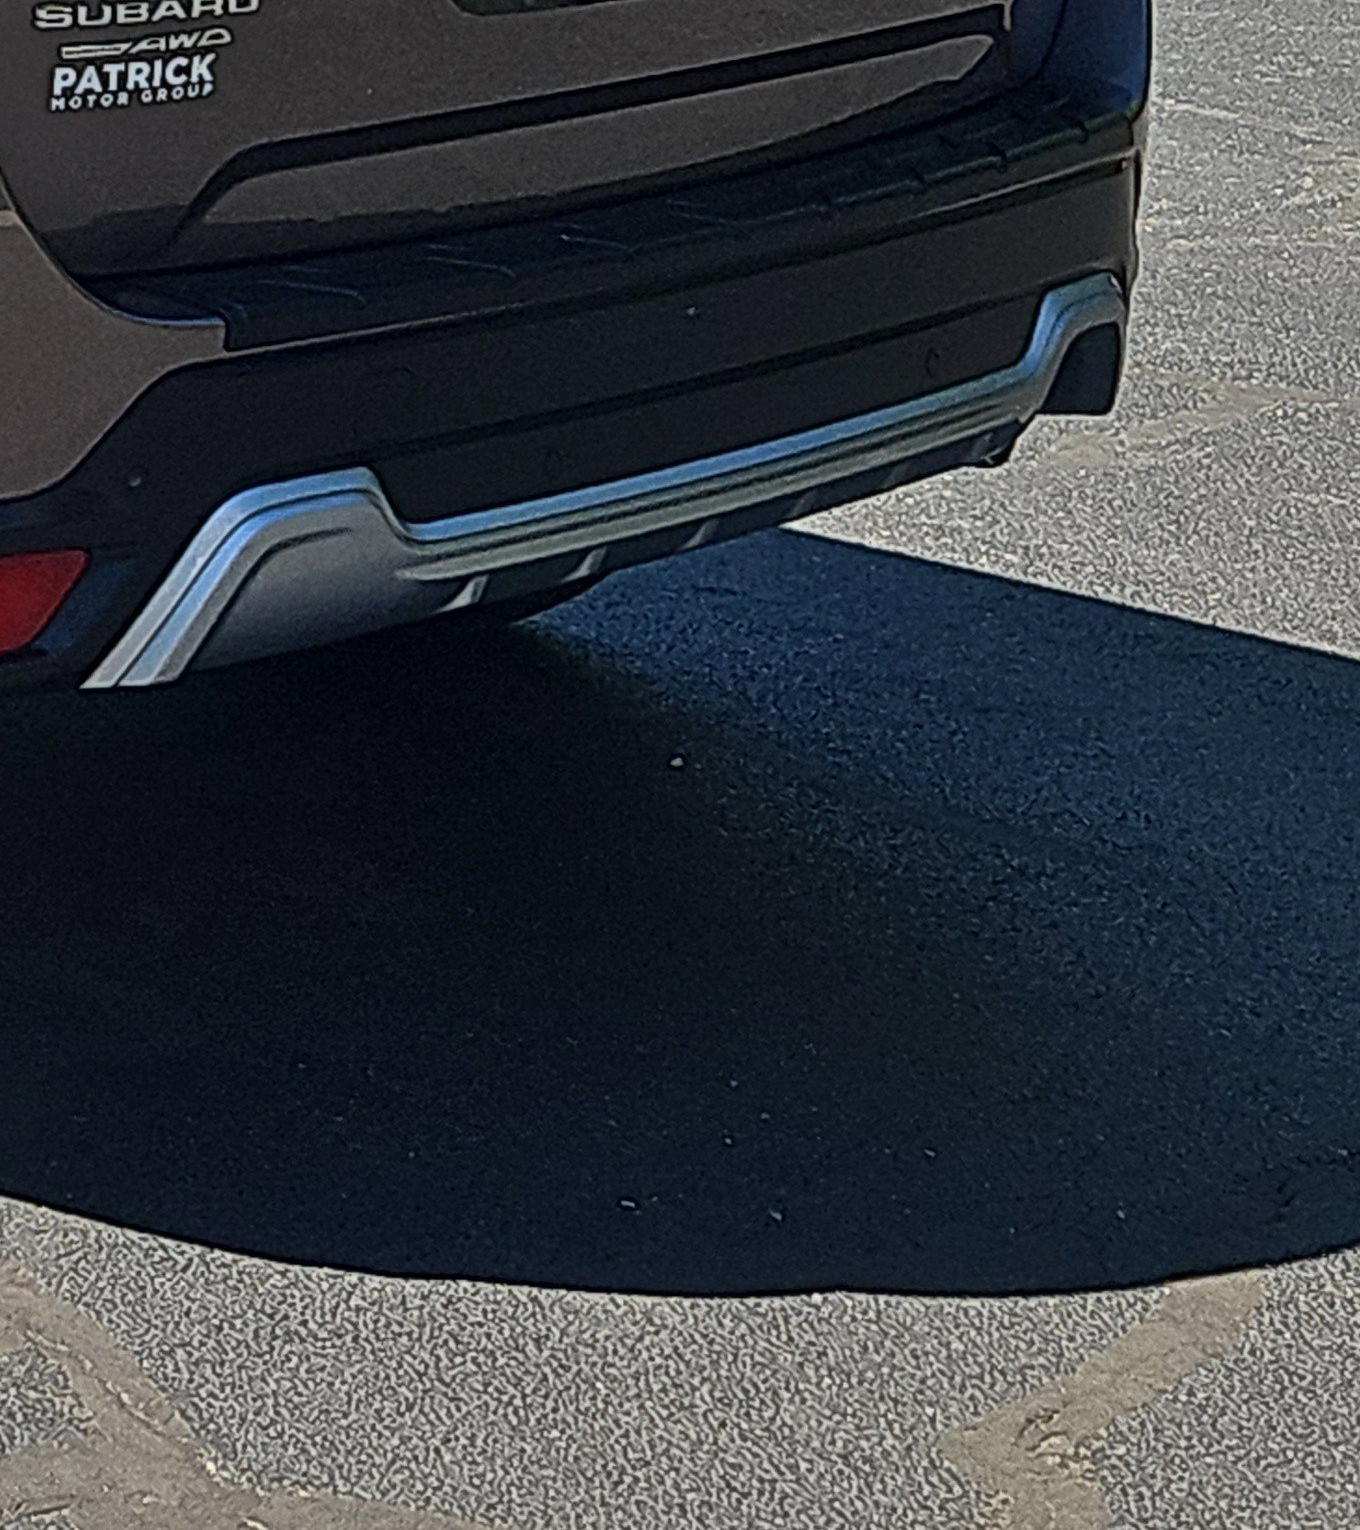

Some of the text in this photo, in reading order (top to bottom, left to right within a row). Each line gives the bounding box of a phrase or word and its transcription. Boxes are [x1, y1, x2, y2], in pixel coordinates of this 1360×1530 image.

[129, 27, 233, 54] AWD
[52, 52, 217, 96] PATRICK
[50, 81, 215, 112] MOTOR GROUP
